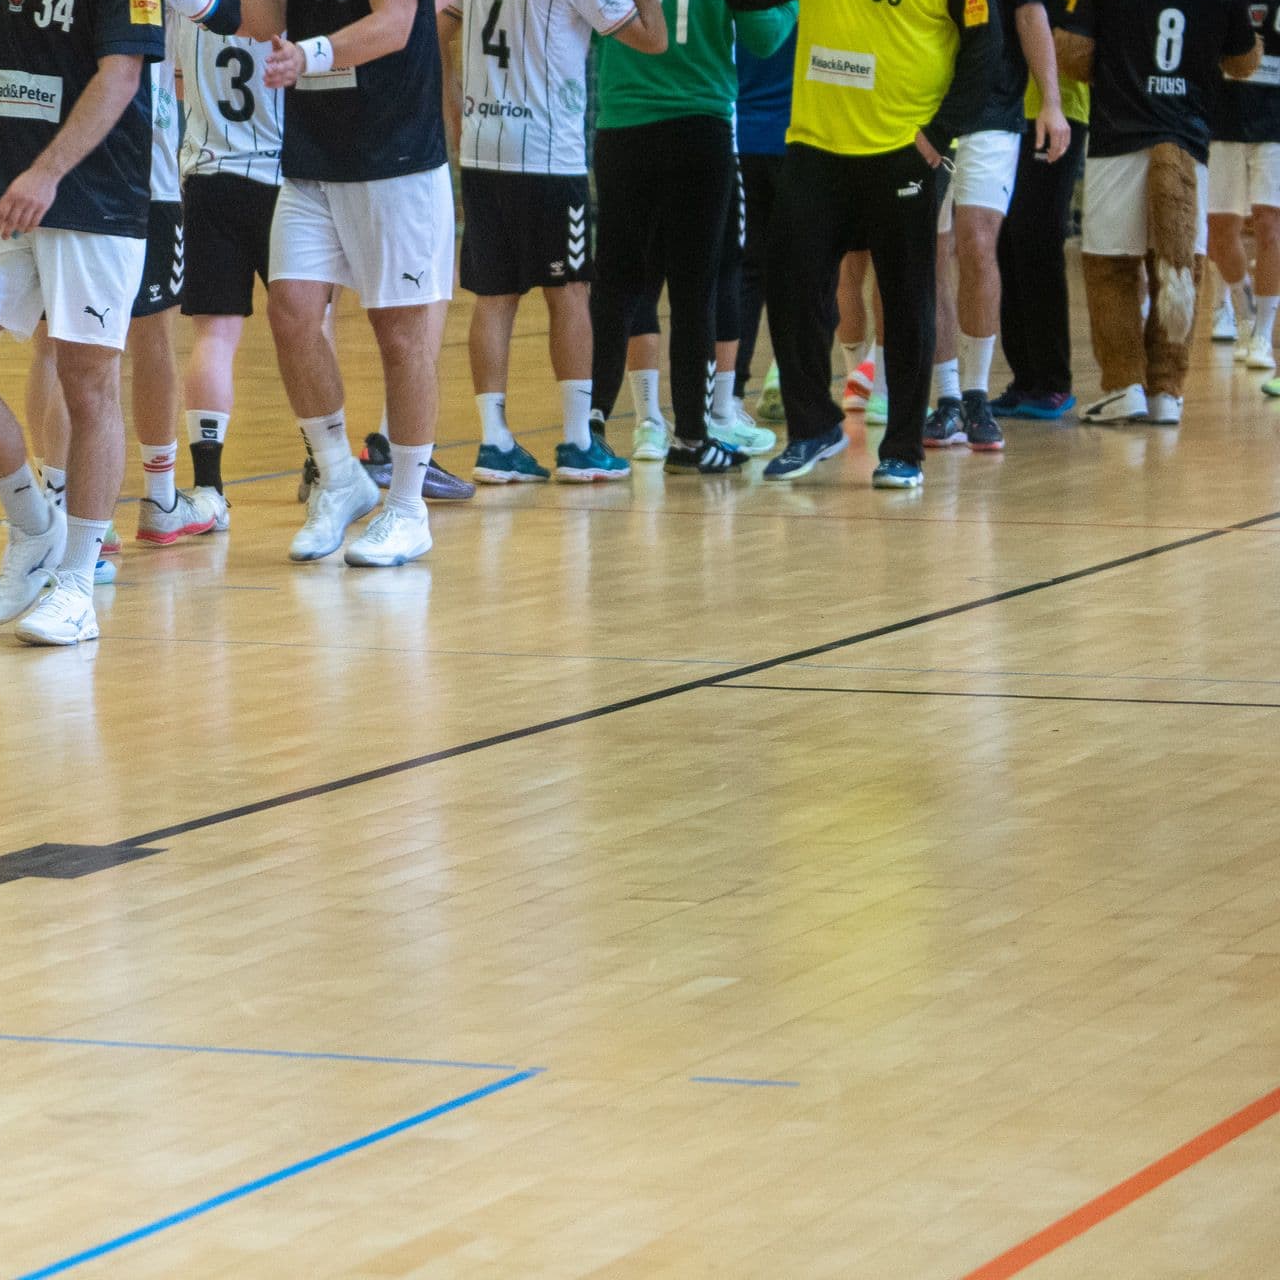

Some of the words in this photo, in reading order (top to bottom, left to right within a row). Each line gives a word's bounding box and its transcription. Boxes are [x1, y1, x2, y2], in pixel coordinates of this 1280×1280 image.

[1156, 7, 1186, 72] 8
[215, 46, 255, 122] 3
[478, 100, 533, 120] quirion
